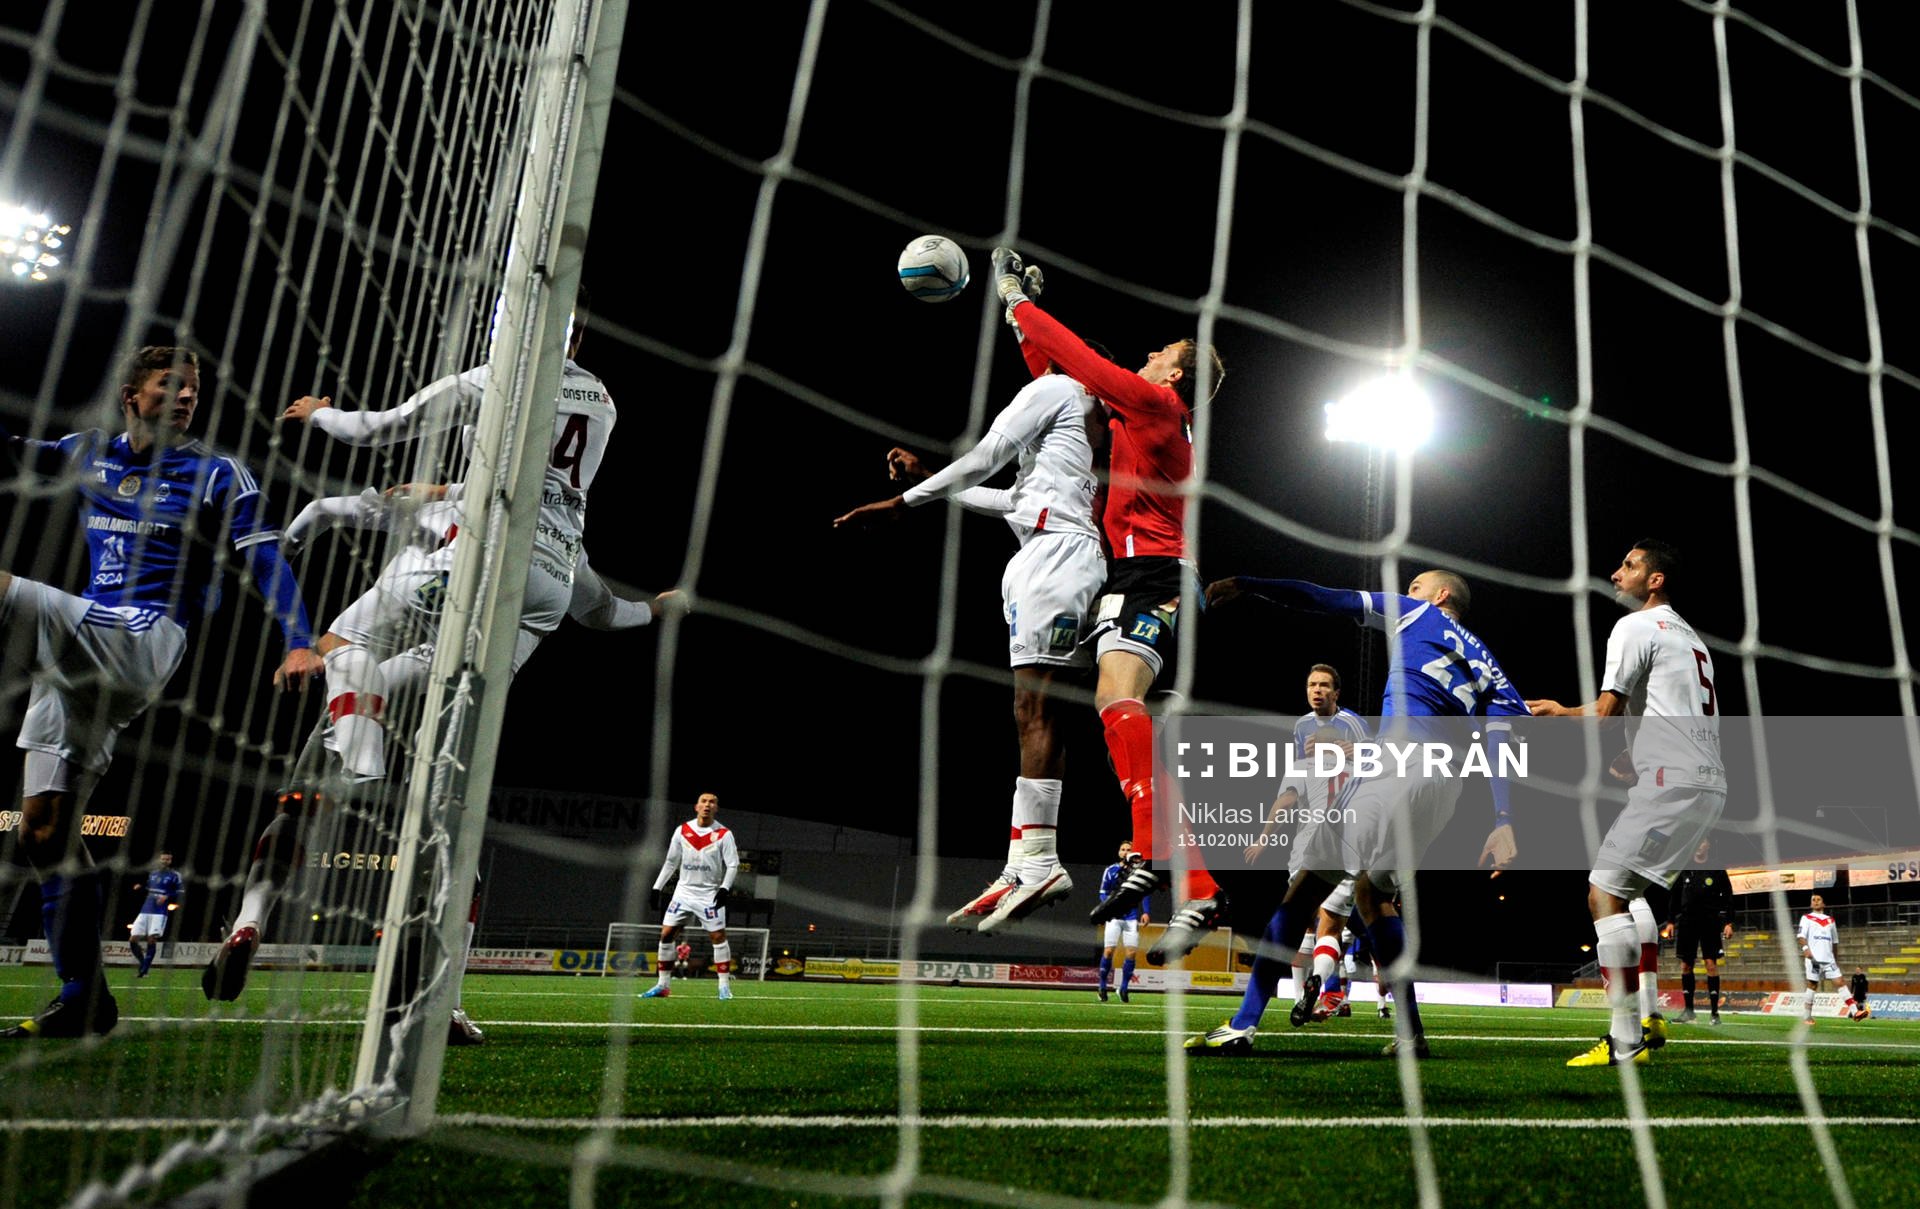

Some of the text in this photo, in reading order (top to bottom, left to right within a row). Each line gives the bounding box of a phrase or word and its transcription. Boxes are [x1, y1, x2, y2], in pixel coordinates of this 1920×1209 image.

[552, 413, 590, 489] 4
[93, 573, 123, 585] SCA
[1050, 628, 1077, 647] LT
[1130, 620, 1160, 640] LT
[1421, 629, 1491, 715] 22
[1691, 648, 1716, 718] 5
[916, 962, 994, 979] PEAB
